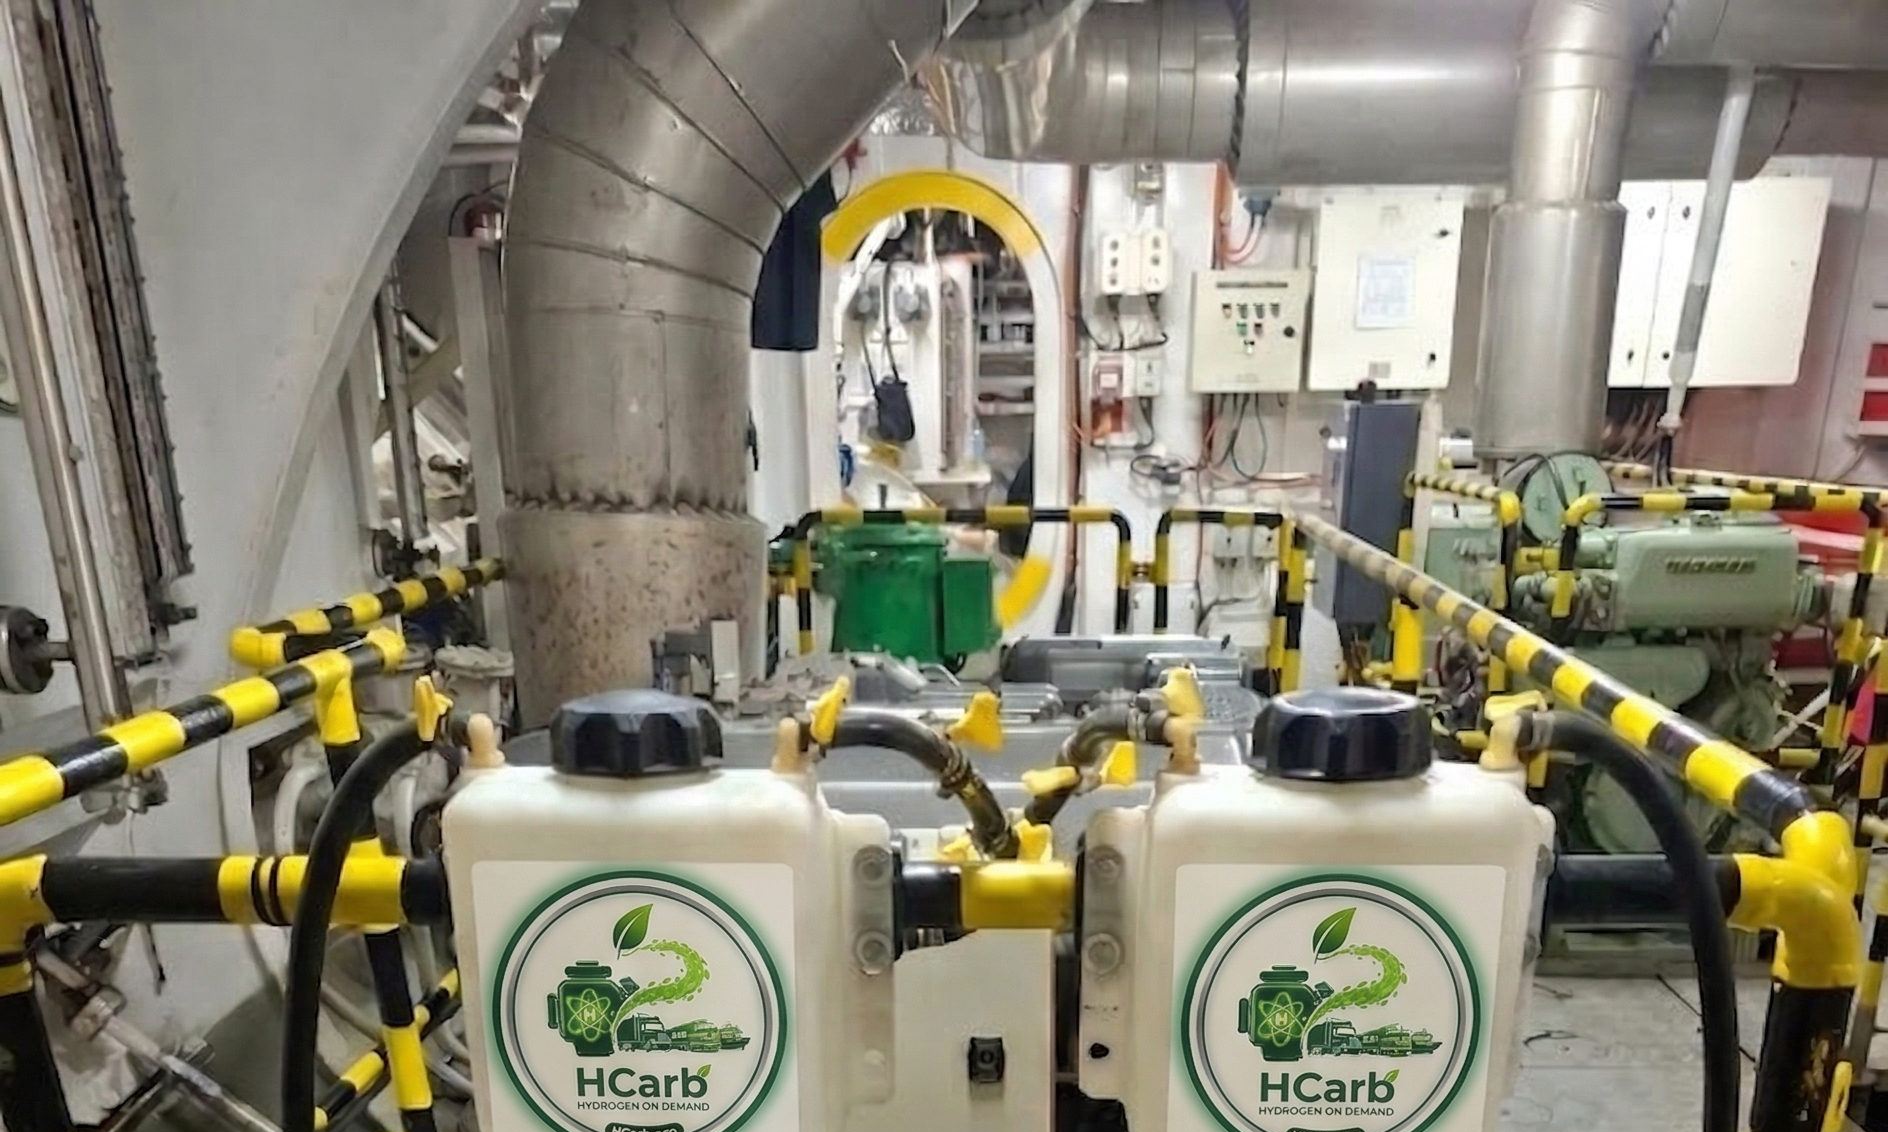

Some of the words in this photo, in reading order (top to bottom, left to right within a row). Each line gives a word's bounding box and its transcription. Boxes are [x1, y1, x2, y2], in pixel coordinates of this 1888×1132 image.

[576, 1067, 708, 1098] HCarb
[1260, 1071, 1395, 1103] HCarb
[577, 1101, 640, 1111] HYDROGEN
[642, 1102, 659, 1111] ON
[661, 1102, 710, 1112] DEMAND
[1258, 1106, 1322, 1116] HYDROGEN
[1325, 1106, 1342, 1116] ON
[1345, 1107, 1394, 1117] DEMAND
